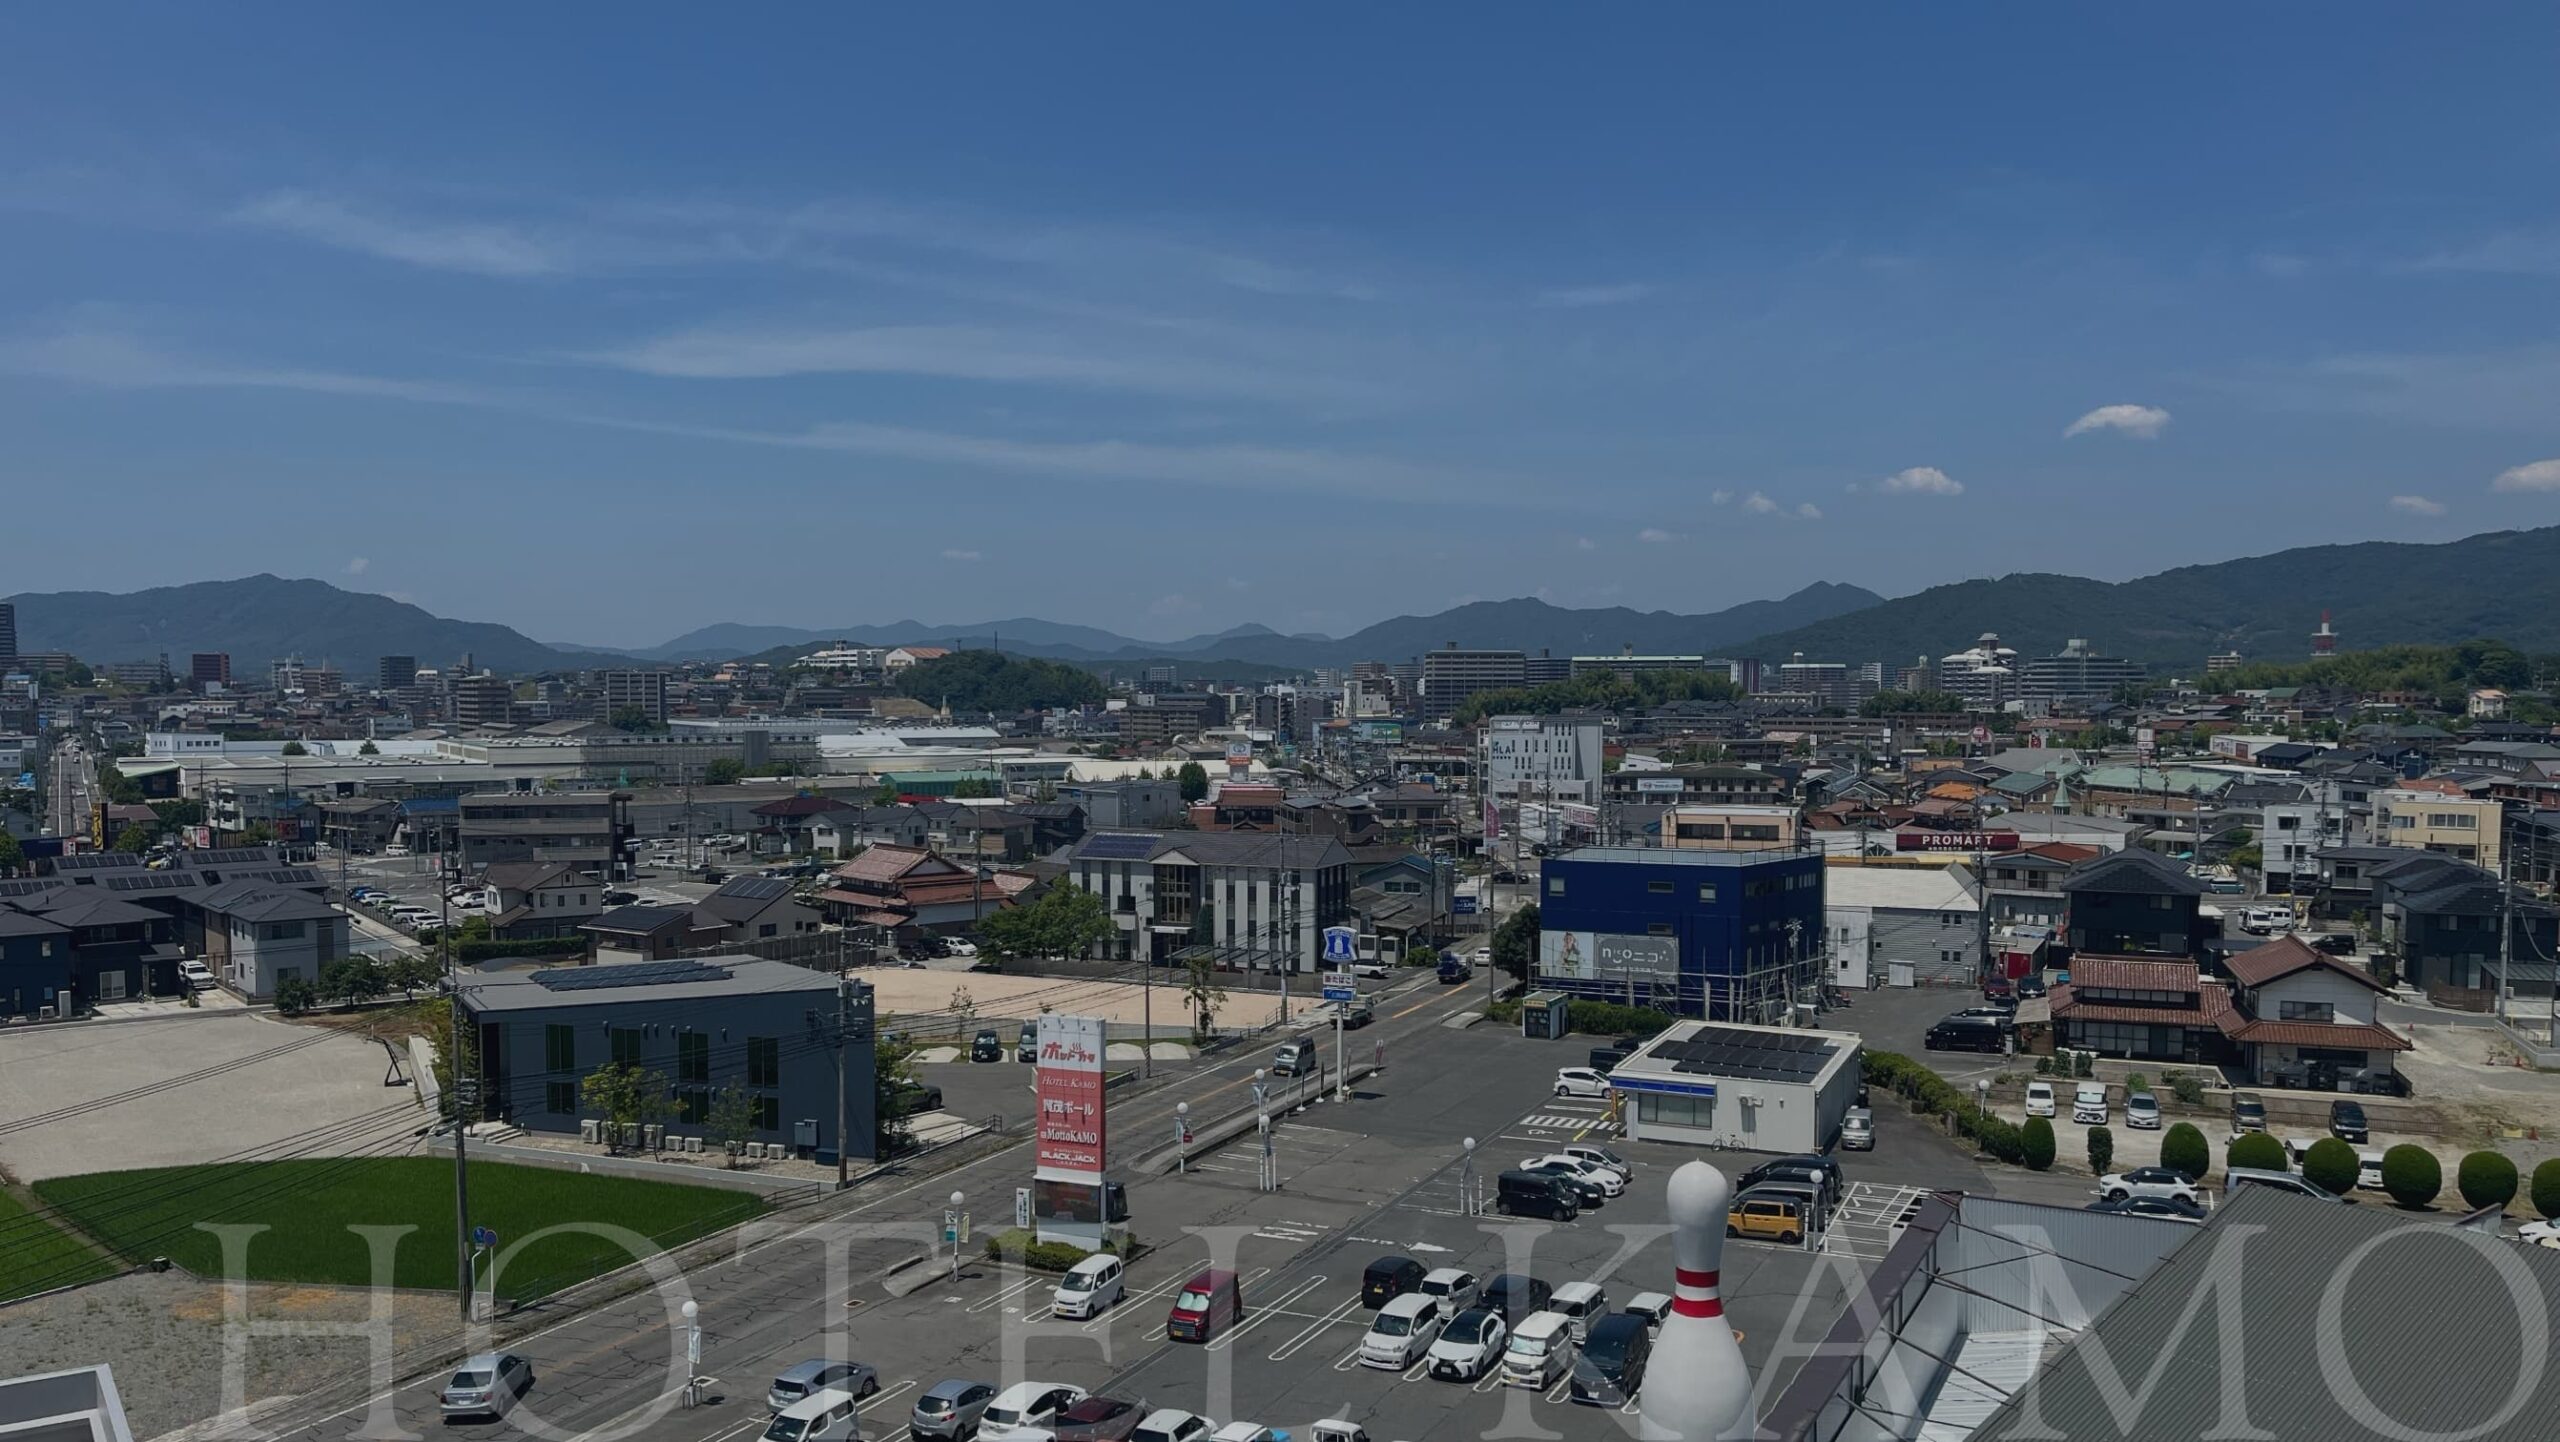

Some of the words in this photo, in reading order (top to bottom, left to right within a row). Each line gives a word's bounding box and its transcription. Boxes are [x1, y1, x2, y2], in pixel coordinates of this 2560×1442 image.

[1042, 1075, 1069, 1088] HOTEL
[1071, 1077, 1097, 1090] KAMO
[1041, 1151, 1070, 1161] BLACK
[1071, 1154, 1096, 1164] JACK
